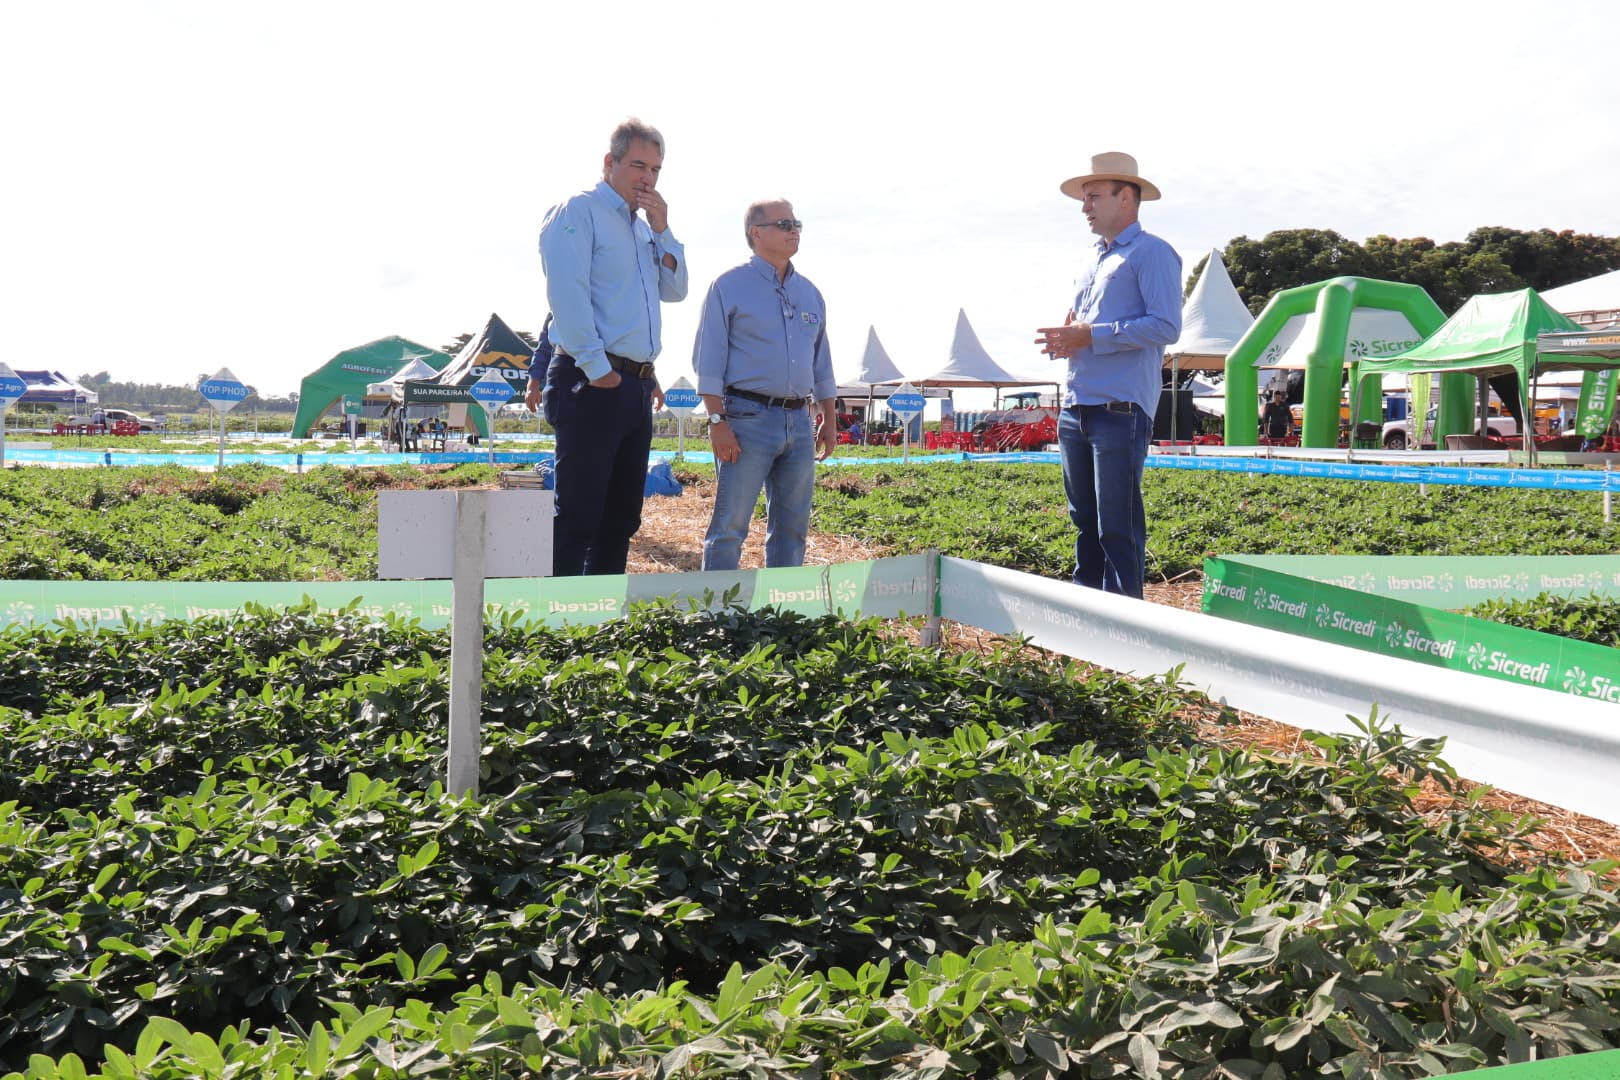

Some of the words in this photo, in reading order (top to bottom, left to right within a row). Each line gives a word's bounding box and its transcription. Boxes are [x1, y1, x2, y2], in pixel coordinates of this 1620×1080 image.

[204, 385, 220, 394] TOP
[223, 386, 246, 396] PHOS
[429, 388, 463, 396] PARCEIRA
[475, 387, 494, 395] TIMAC
[496, 388, 510, 396] Agro
[1211, 578, 1247, 602] Sicredi
[1267, 594, 1309, 620] Sicredi
[1331, 611, 1377, 639] Sicredi
[1402, 629, 1457, 660] Sicredi
[1487, 650, 1551, 684] Sicredi
